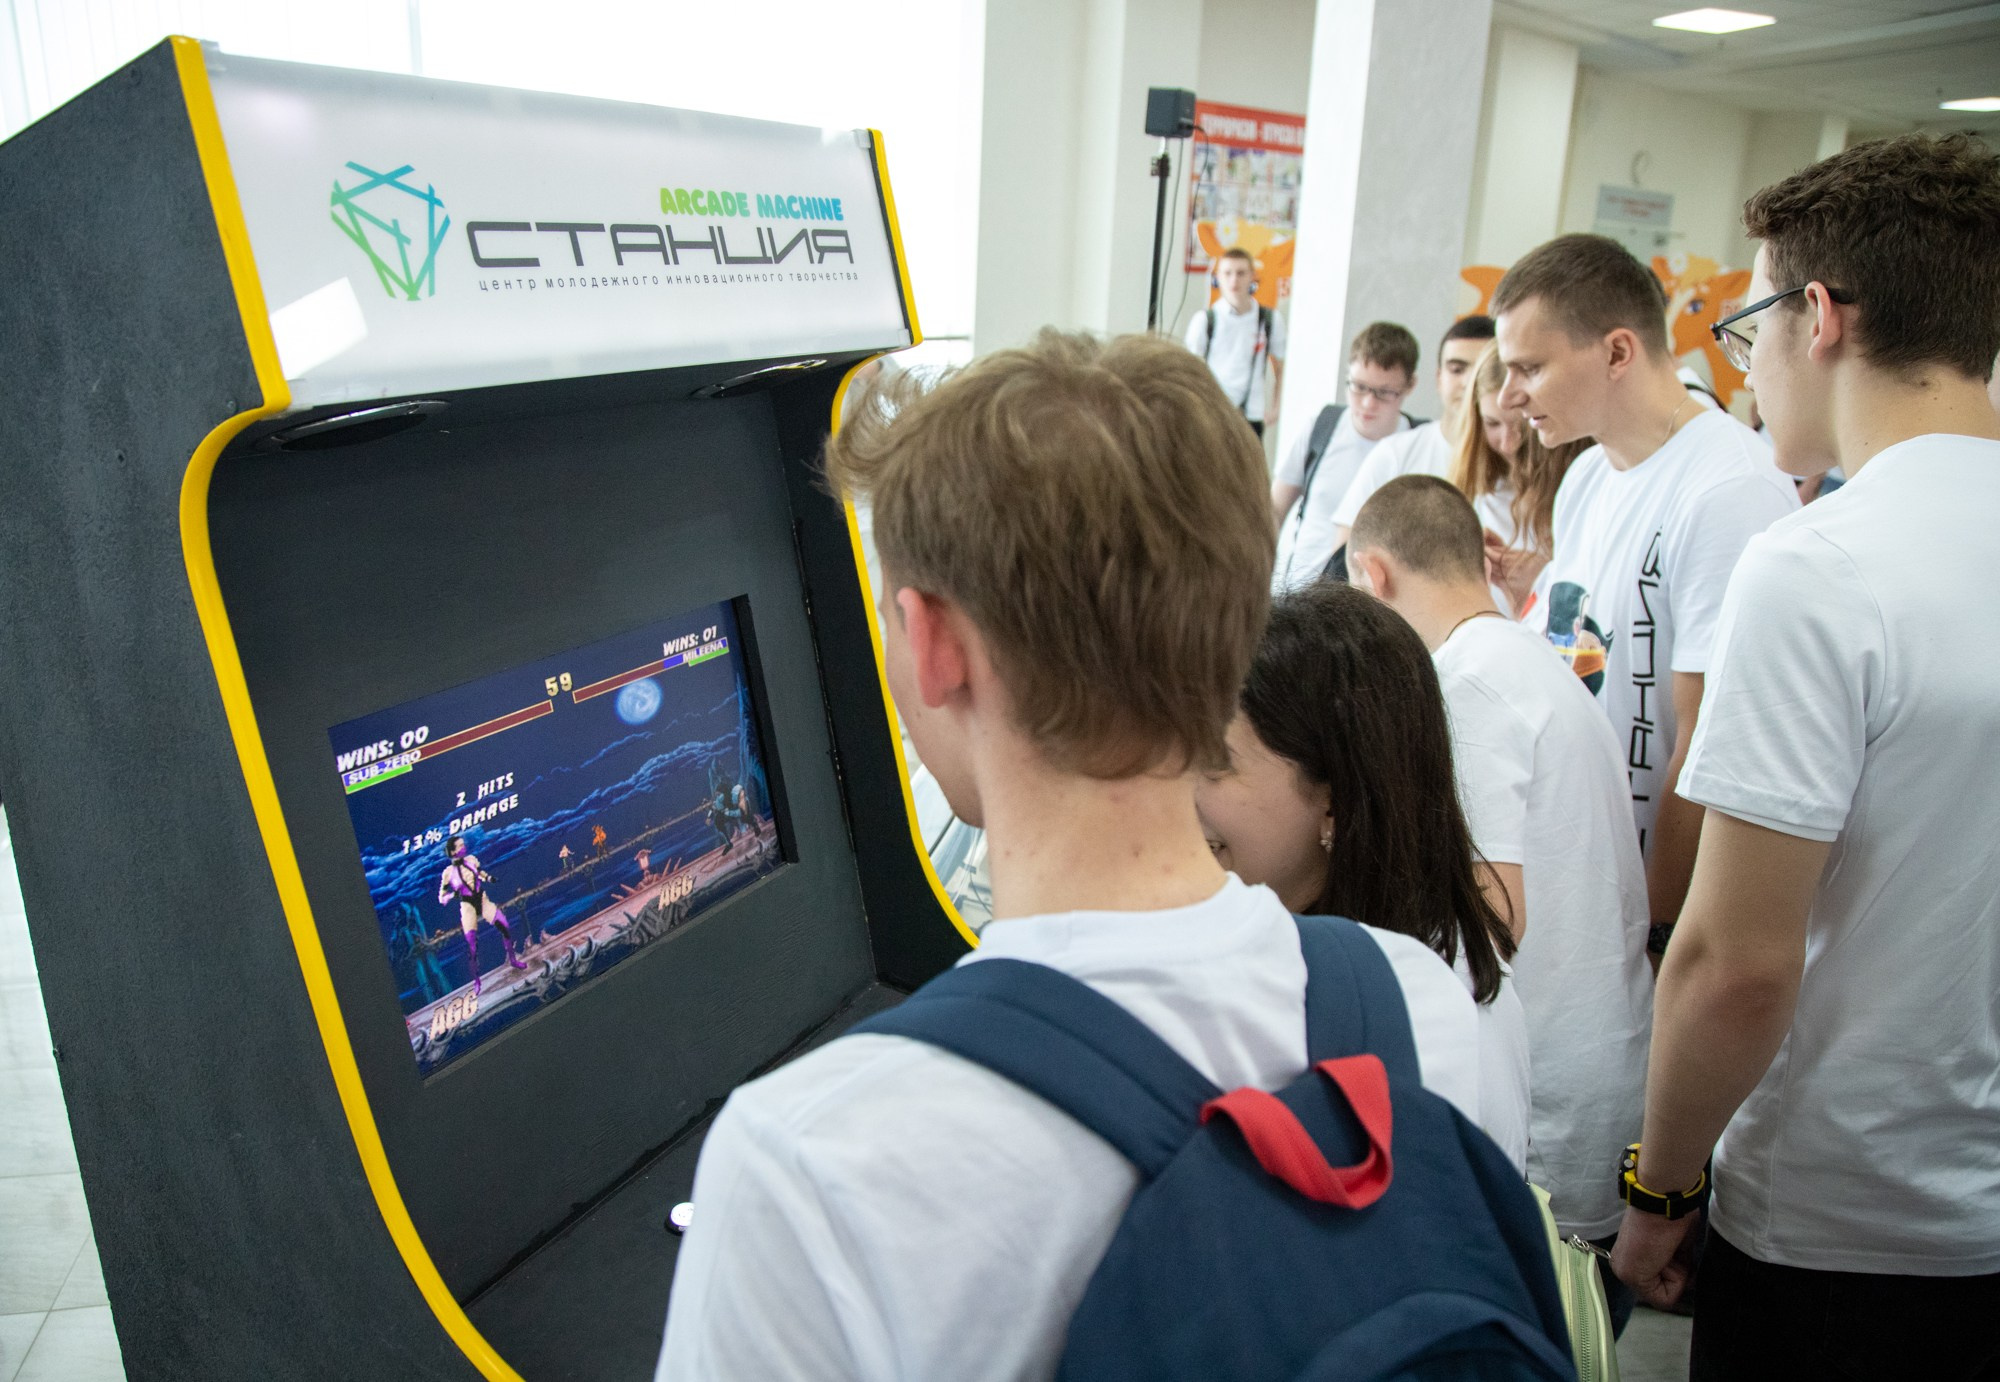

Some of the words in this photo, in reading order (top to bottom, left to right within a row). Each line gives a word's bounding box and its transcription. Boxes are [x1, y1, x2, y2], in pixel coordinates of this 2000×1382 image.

[660, 187, 750, 218] ARCADE
[756, 193, 844, 221] MACHINE
[467, 221, 855, 268] СТАНЦИЯ
[479, 277, 537, 292] центр
[545, 274, 659, 289] молодежного
[666, 272, 784, 286] инновационного
[789, 271, 859, 283] творчества
[663, 633, 700, 657] WINS:
[702, 625, 717, 642] 01
[544, 671, 573, 697] 59
[1628, 524, 1664, 858] АНЦИЯ
[336, 739, 395, 773] WINS:
[400, 725, 430, 749] 00
[456, 791, 466, 808] 2
[478, 772, 514, 801] HITS
[402, 828, 443, 855] 13%
[449, 794, 519, 835] DAMAGE
